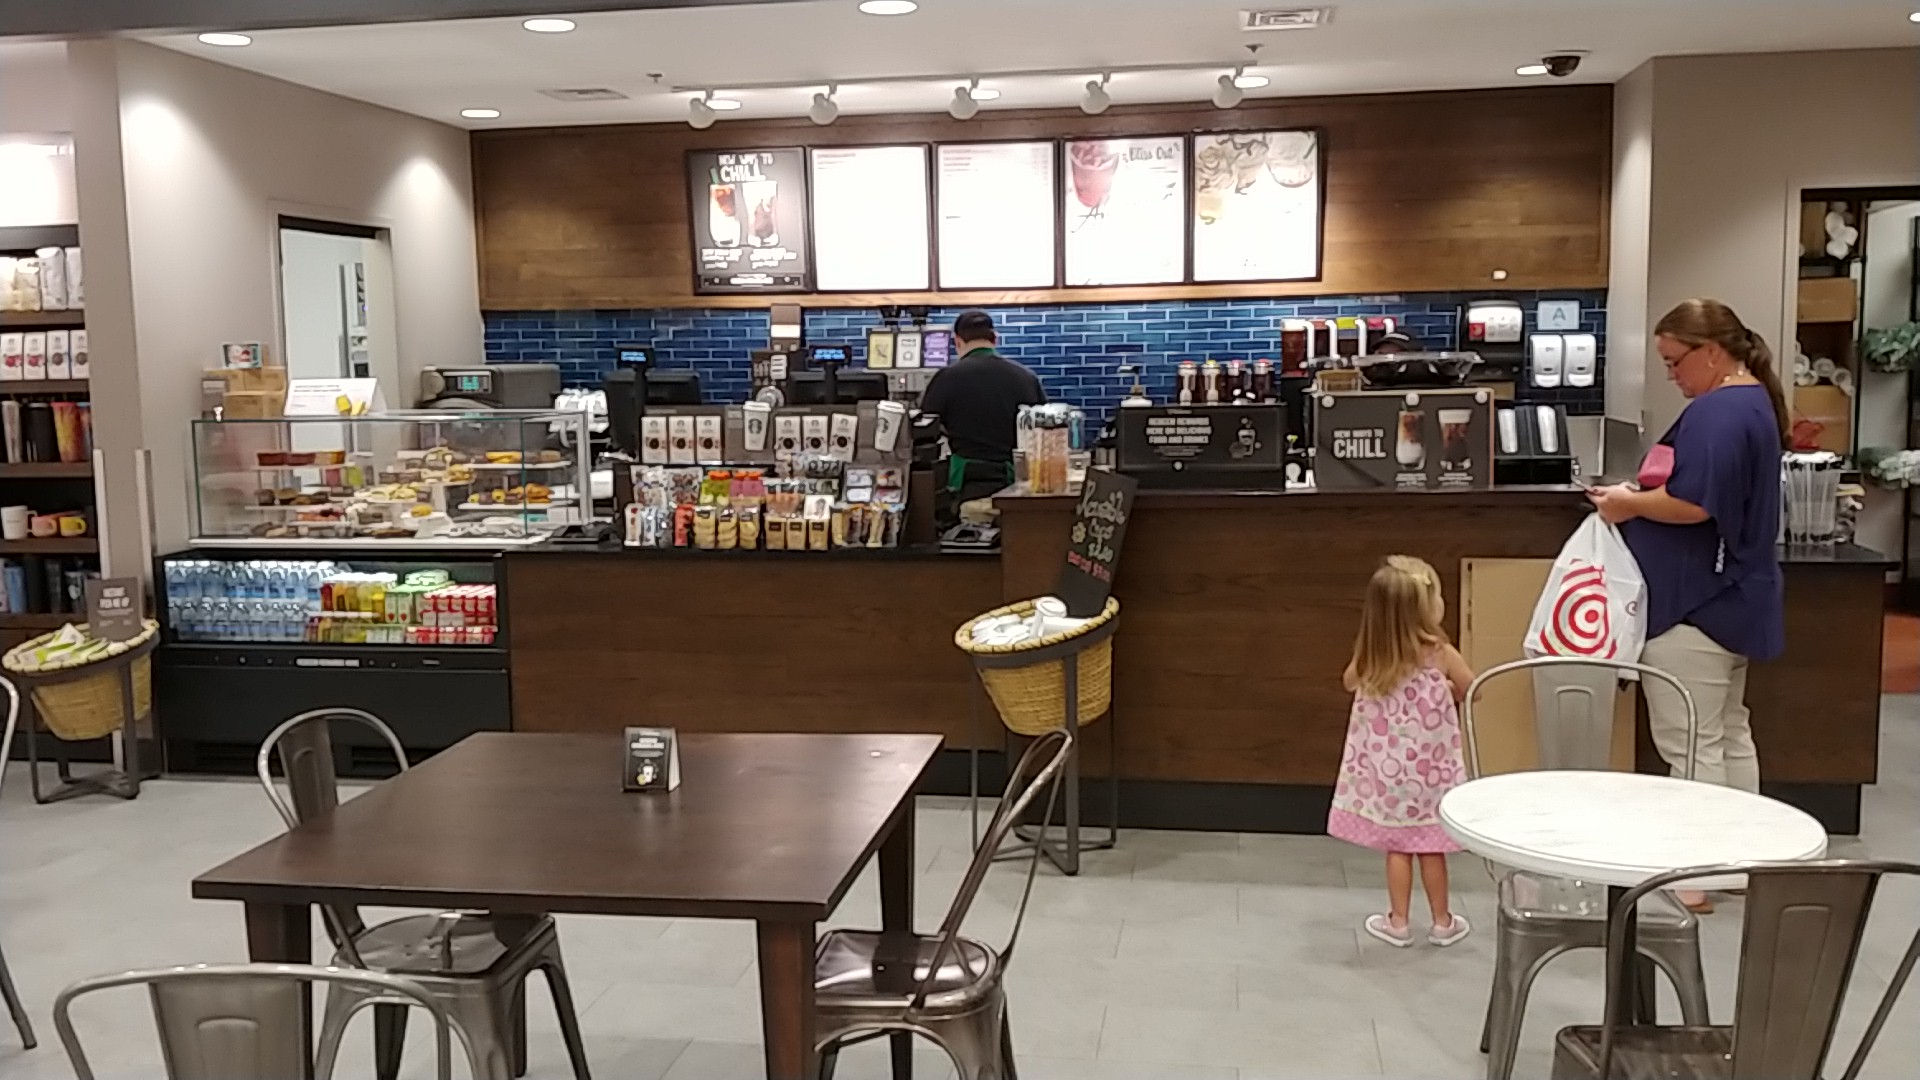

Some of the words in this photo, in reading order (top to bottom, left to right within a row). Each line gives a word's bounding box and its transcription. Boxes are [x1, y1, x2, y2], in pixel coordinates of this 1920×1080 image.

[720, 164, 766, 182] CHILL
[1552, 307, 1566, 320] A
[1334, 430, 1350, 438] NEW
[1333, 438, 1387, 458] CHILL
